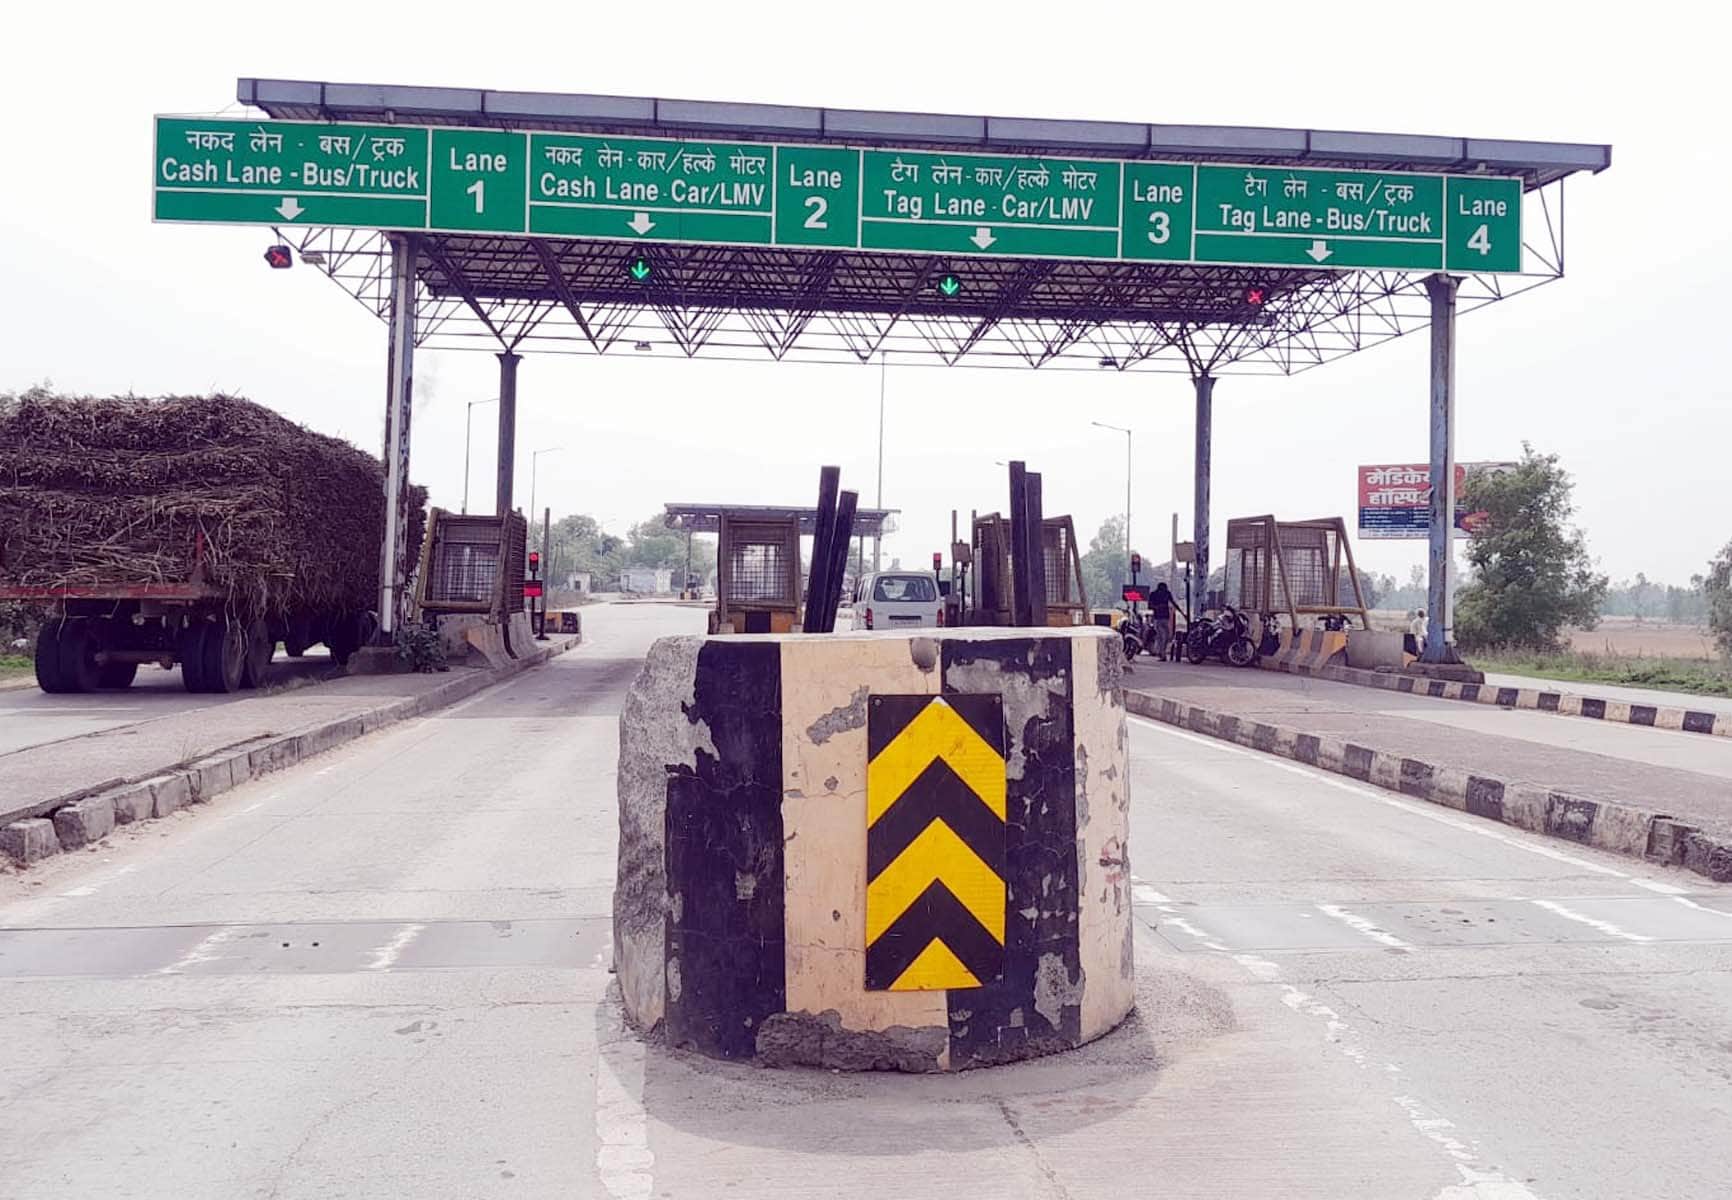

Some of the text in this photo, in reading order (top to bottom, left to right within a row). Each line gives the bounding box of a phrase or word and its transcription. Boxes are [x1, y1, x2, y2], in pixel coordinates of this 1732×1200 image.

[186, 131, 235, 151] नकद
[250, 126, 282, 152] लेन
[319, 135, 405, 160] बस/ट्रक
[162, 158, 217, 181] Cash
[227, 160, 281, 184] Lane
[304, 162, 418, 188] Bus/Truck
[451, 148, 506, 172] Lane
[545, 147, 582, 166] नकद
[597, 143, 623, 168] लेन
[638, 148, 716, 174] कार/हल्के
[730, 149, 766, 175] मोटर
[891, 157, 918, 182] टैग
[932, 160, 962, 184] लेन
[975, 163, 1049, 190] कार/हल्के
[1062, 165, 1097, 189] मोटर
[541, 173, 595, 197] Cash
[606, 177, 658, 201] Lane
[672, 179, 764, 205] Car/LMV
[790, 164, 841, 188] Lane
[1134, 180, 1182, 203] Lane
[1245, 173, 1267, 196] टैग
[1284, 176, 1307, 197] लेन
[1336, 180, 1413, 205] बस/ट्रक
[467, 180, 483, 213] 1
[883, 190, 922, 219] Tag
[935, 193, 985, 216] Lane
[1003, 194, 1093, 219] Car/LMV
[1460, 195, 1506, 216] Lane
[804, 197, 827, 228] 2
[1148, 212, 1170, 243] 3
[1219, 204, 1255, 232] Tag
[1264, 206, 1311, 228] Lane
[1327, 208, 1430, 232] Bus/Truck
[1468, 224, 1491, 255] 4
